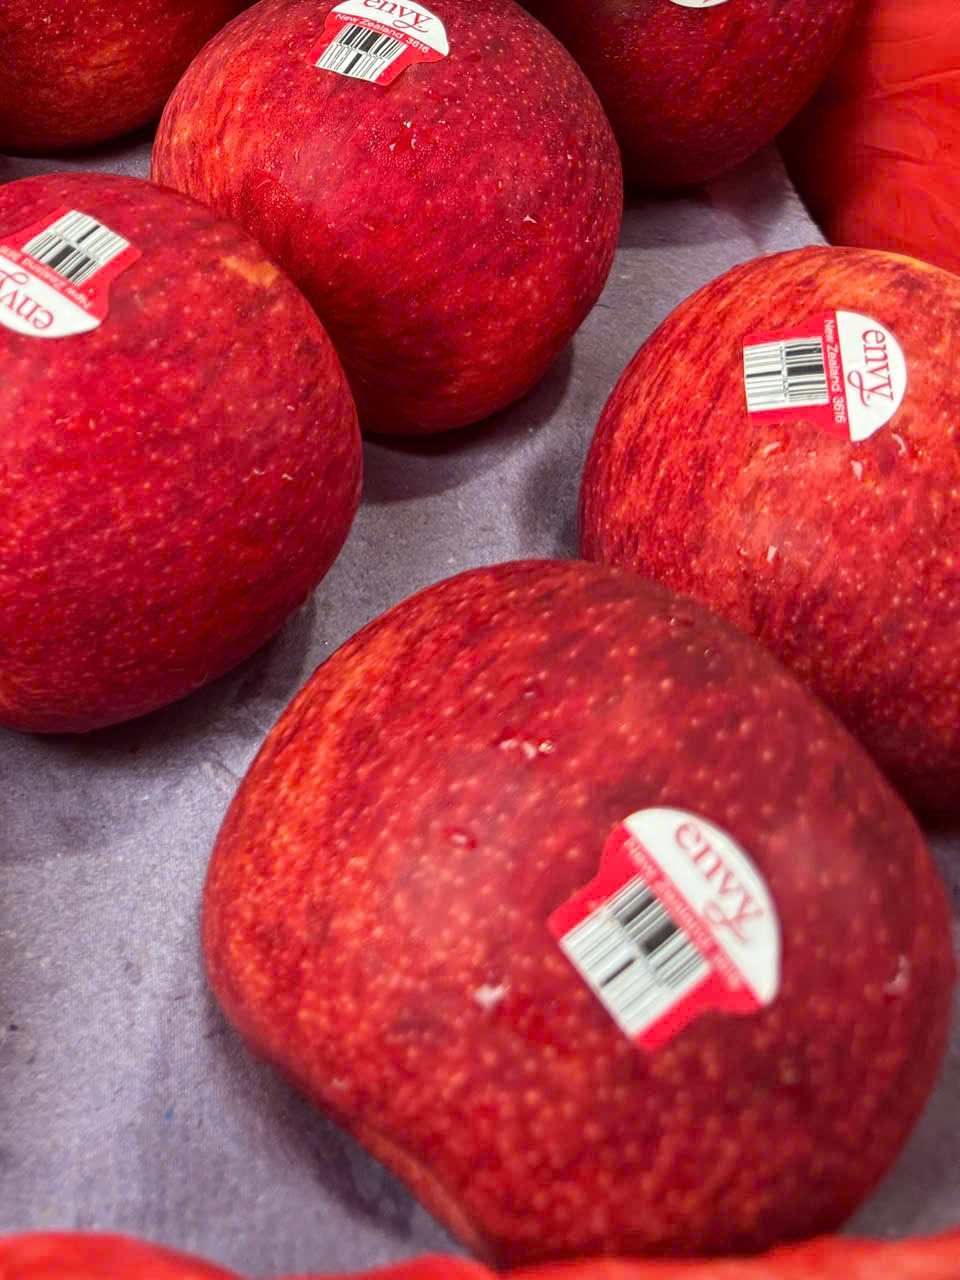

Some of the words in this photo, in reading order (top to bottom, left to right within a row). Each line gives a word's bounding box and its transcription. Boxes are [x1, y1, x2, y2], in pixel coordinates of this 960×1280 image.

[334, 13, 358, 25] New
[359, 18, 405, 41] Zealand
[824, 319, 835, 343] New
[825, 344, 841, 392] Zealand
[847, 328, 895, 407] envy
[833, 395, 847, 424] 3616
[674, 822, 763, 944] envy
